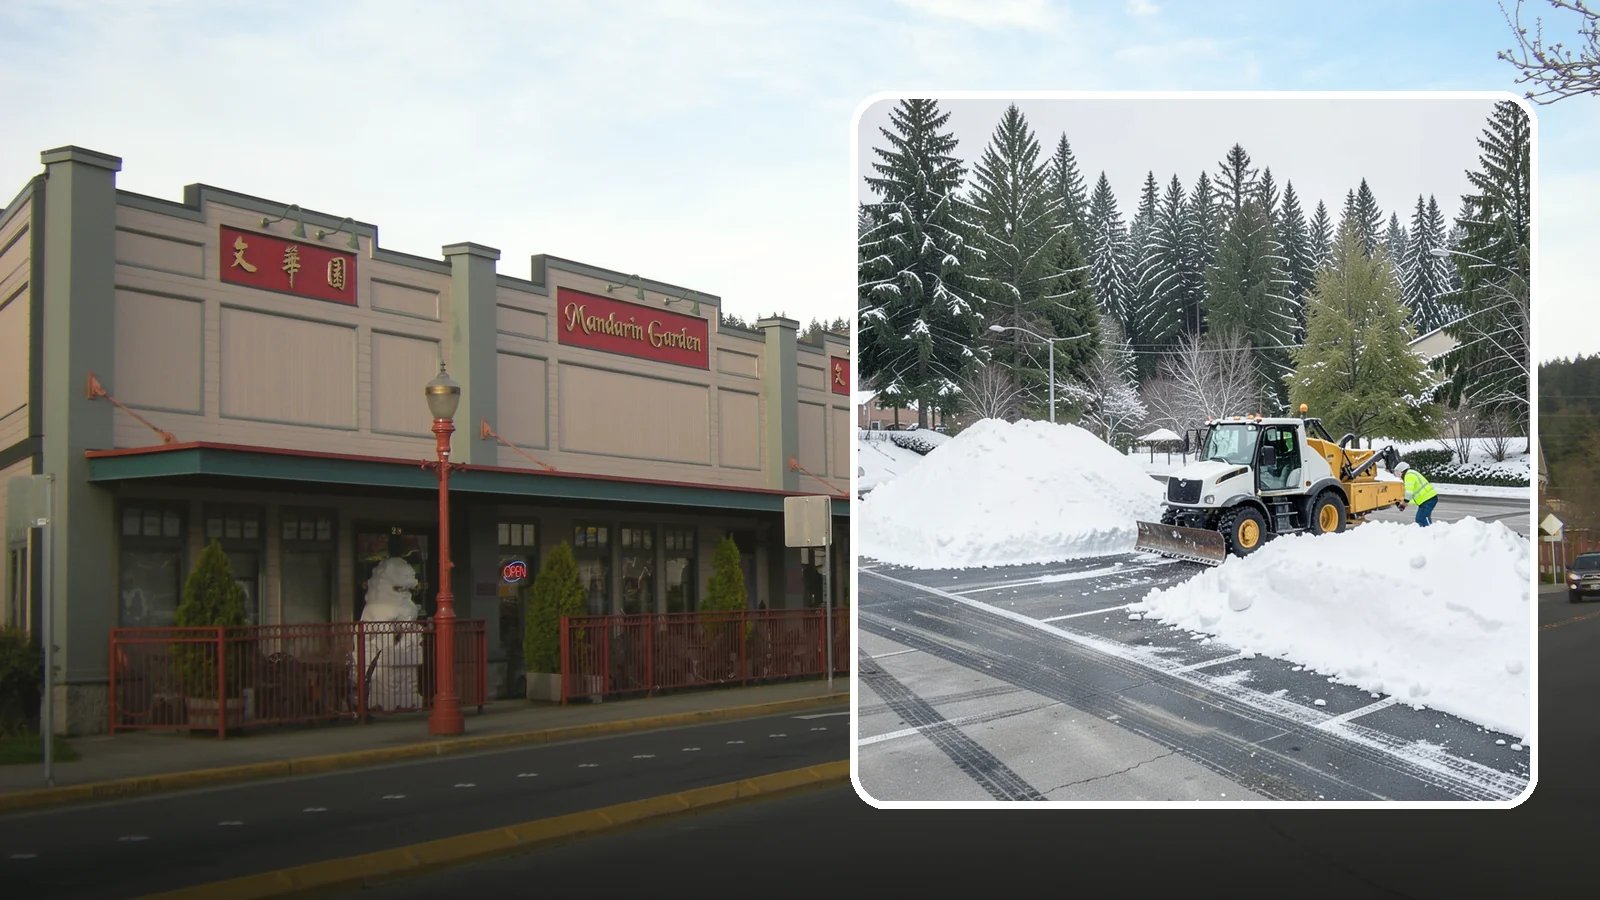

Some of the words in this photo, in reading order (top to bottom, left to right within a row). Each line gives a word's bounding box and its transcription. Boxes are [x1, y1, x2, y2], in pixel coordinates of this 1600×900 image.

[231, 235, 347, 291] 文華園
[564, 302, 644, 341] Mandarin
[647, 320, 701, 352] Garden
[834, 363, 846, 387] 文
[503, 565, 527, 578] OPEN
